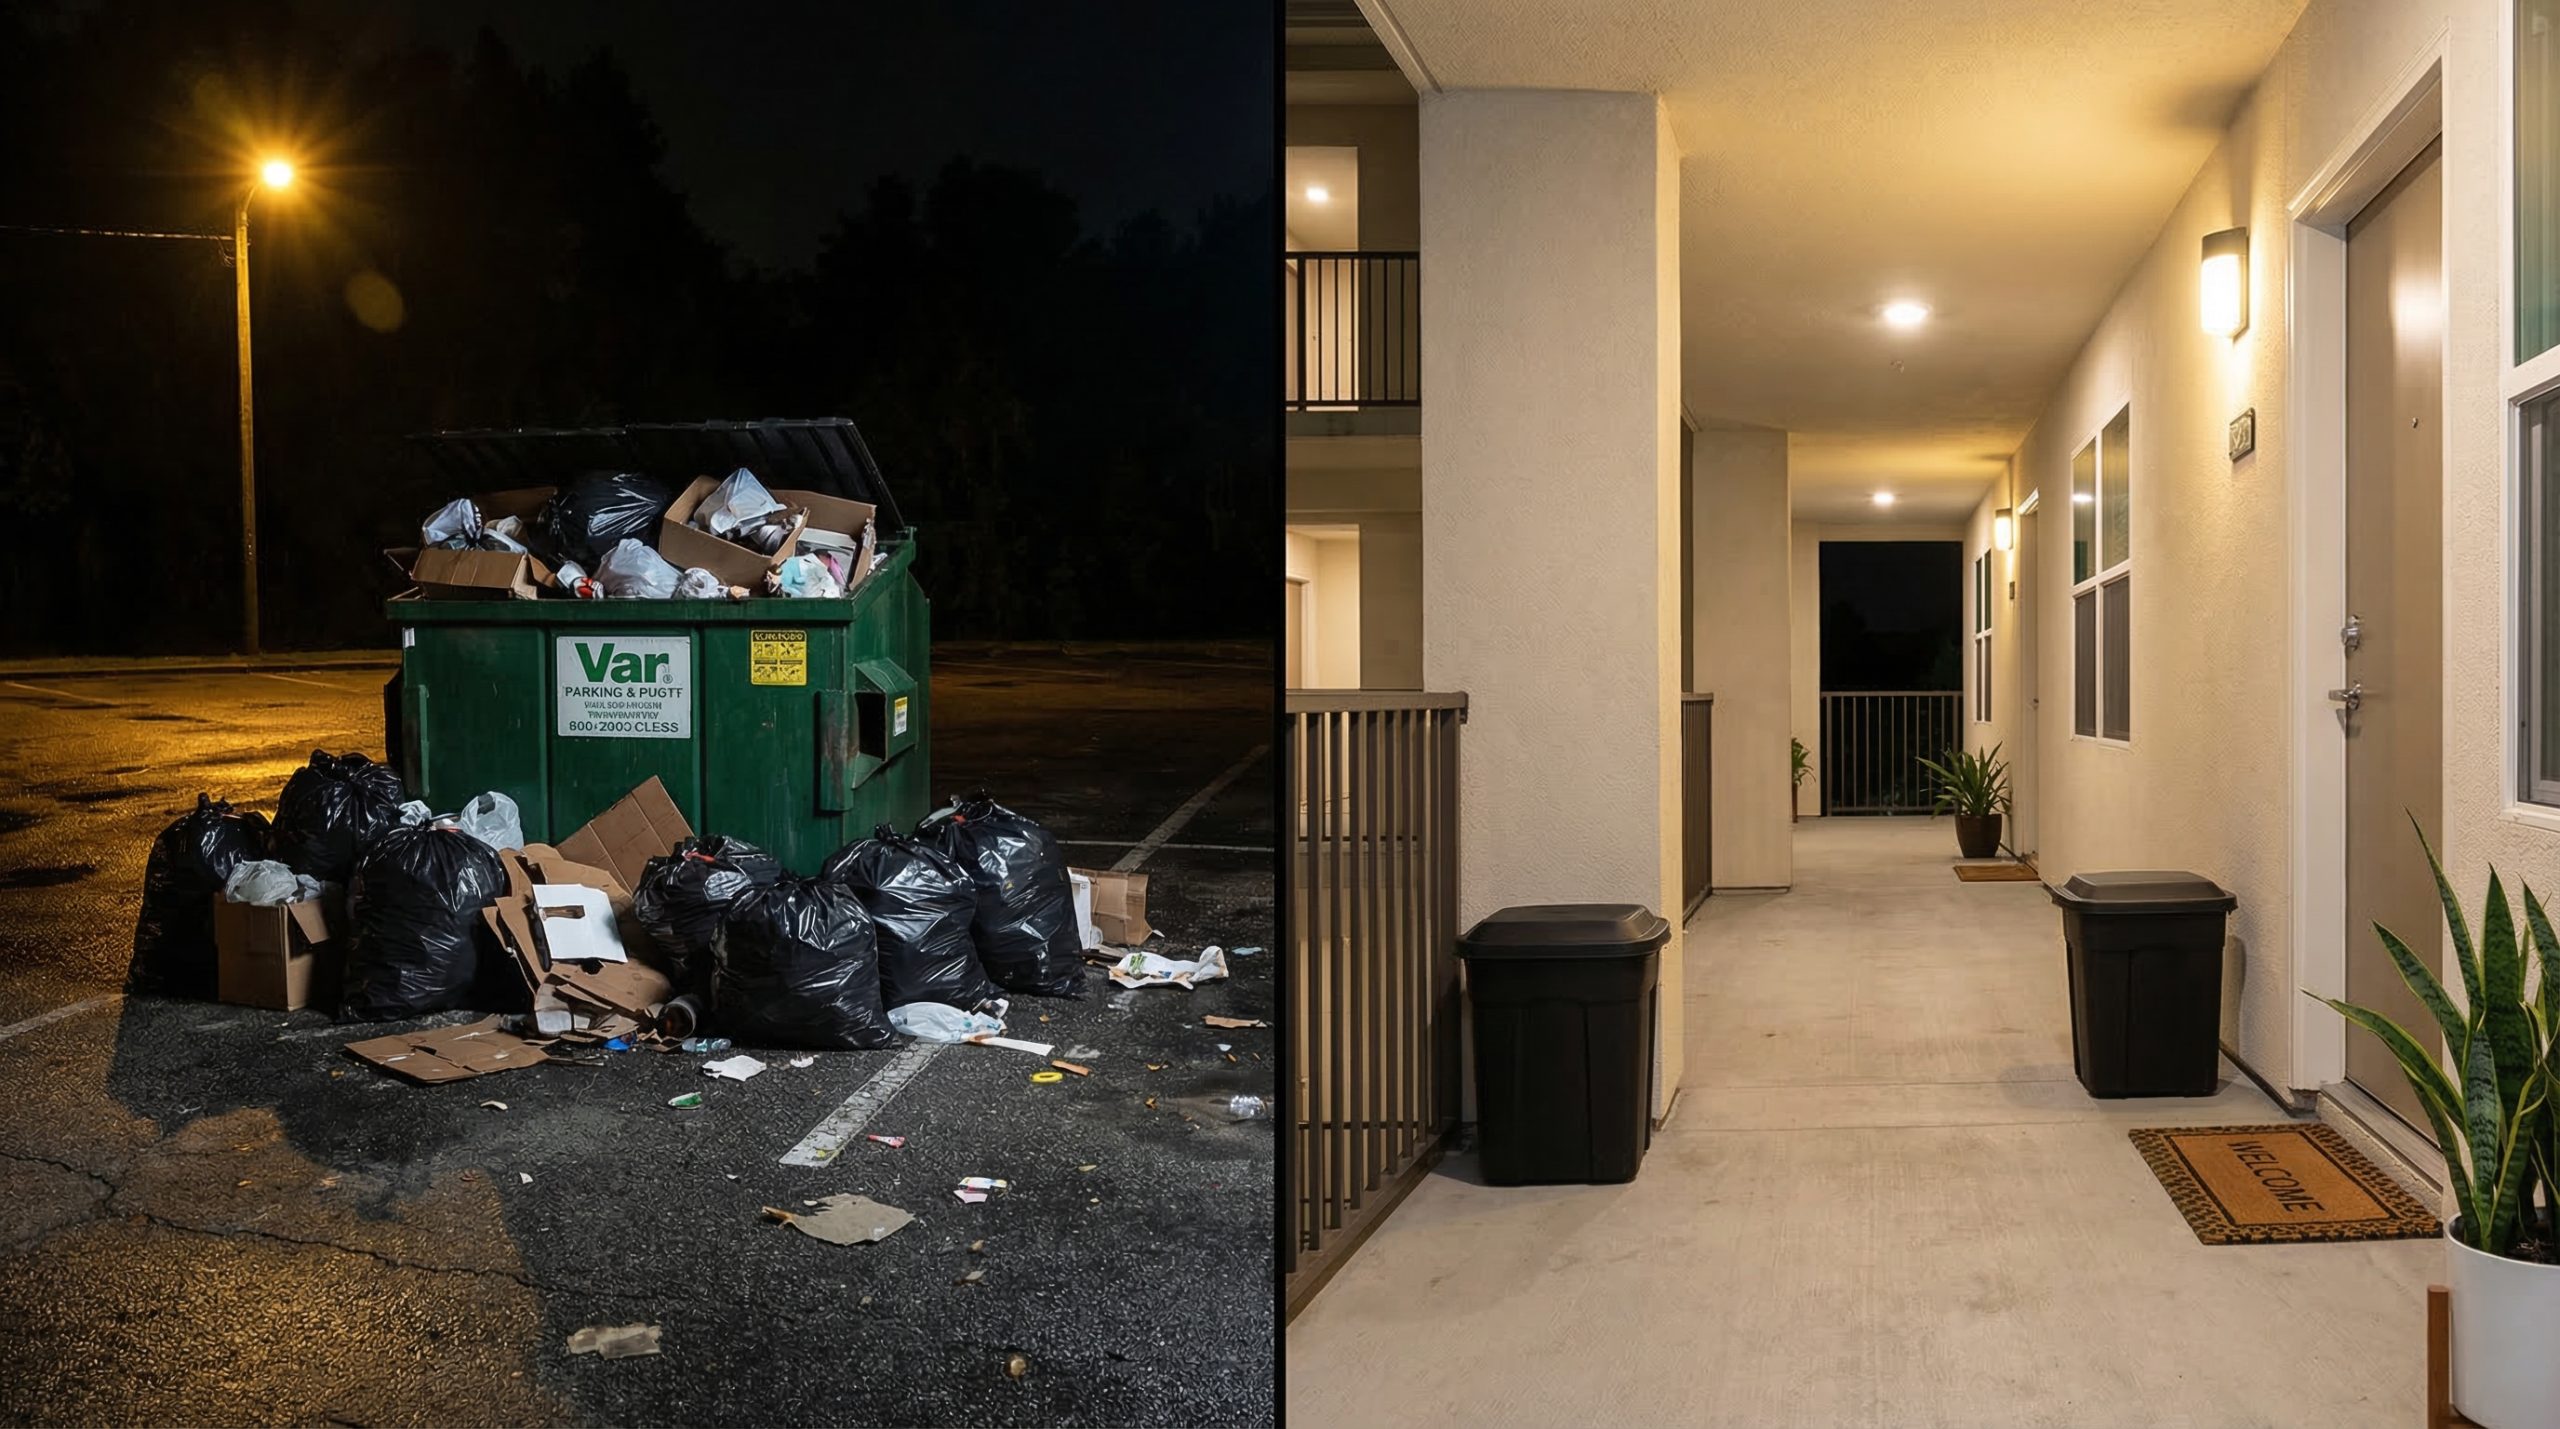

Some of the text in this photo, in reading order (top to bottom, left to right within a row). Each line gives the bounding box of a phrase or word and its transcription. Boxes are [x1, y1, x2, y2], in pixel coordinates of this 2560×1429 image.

[575, 643, 669, 683] Var
[565, 686, 622, 698] PARKING
[626, 687, 635, 698] &
[634, 721, 679, 733] CLESS
[2227, 1140, 2325, 1213] WELCOME
